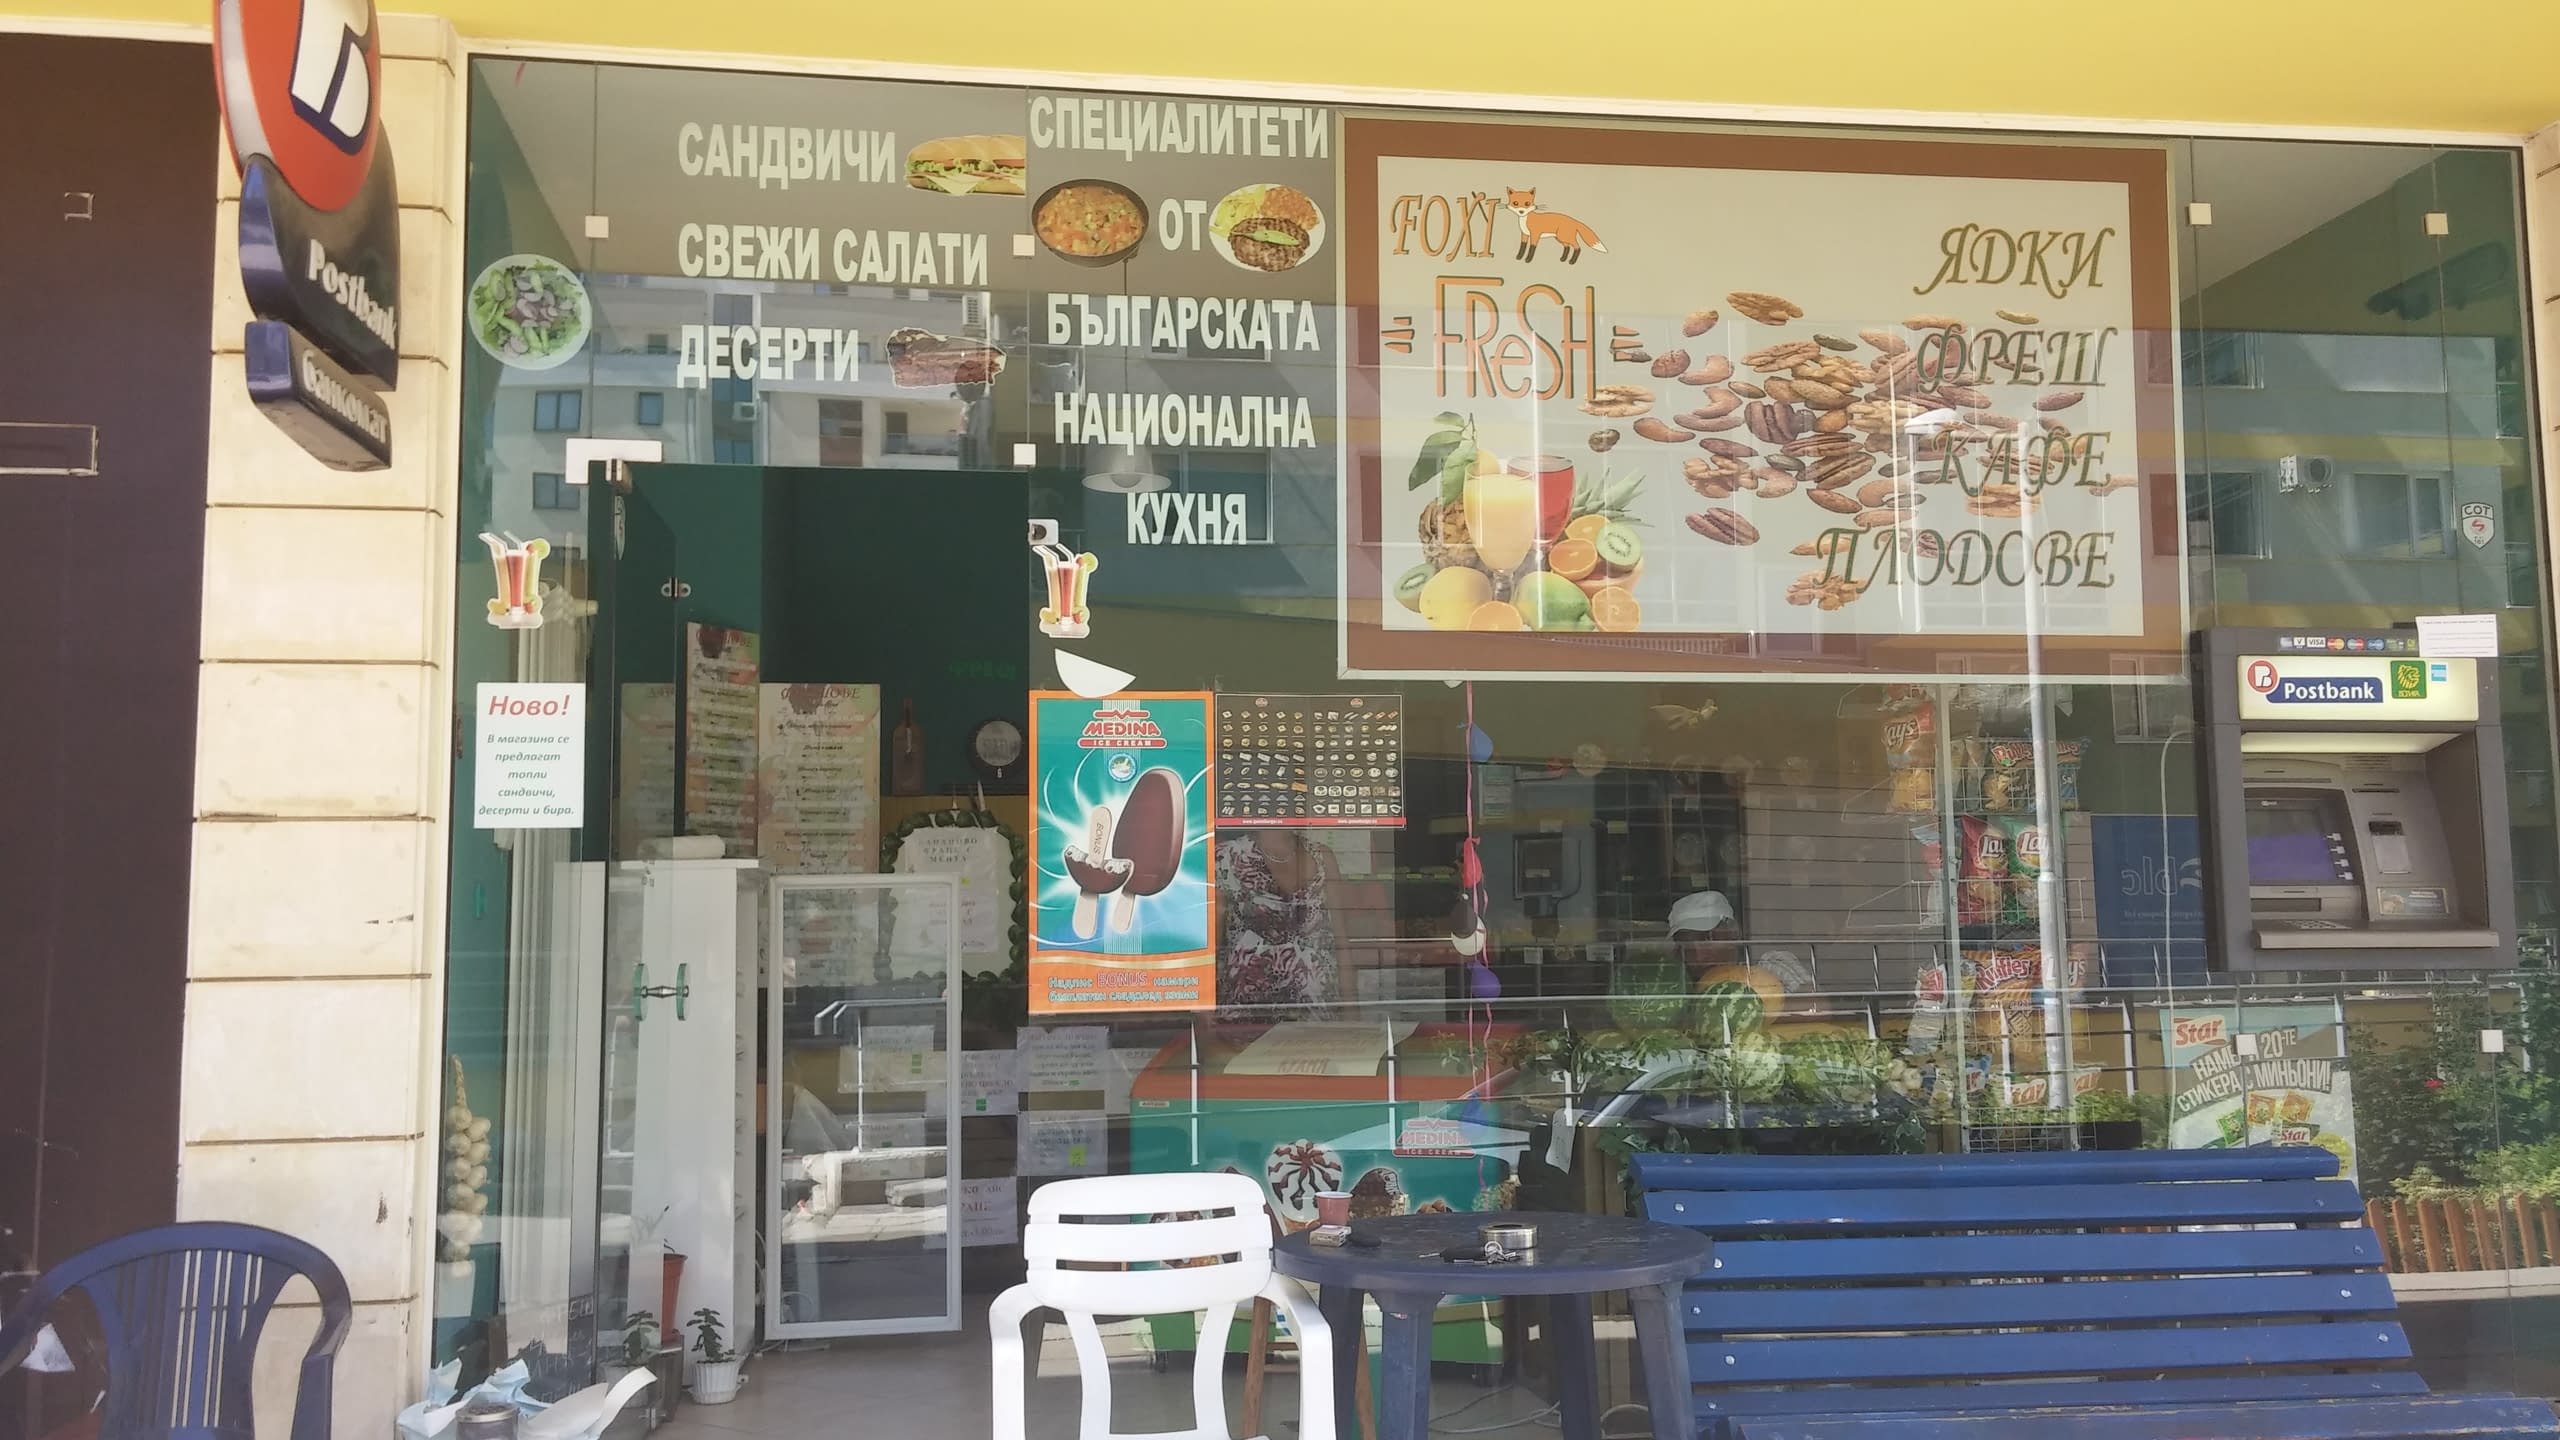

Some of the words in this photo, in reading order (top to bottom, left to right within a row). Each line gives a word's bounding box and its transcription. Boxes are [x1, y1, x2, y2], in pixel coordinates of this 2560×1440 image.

[1030, 96, 1328, 161] СПЕЦИАЛИТЕТИ
[678, 122, 896, 190] САНДВИЧИ
[1158, 198, 1207, 251] ОТ
[678, 223, 820, 280] СВЕЖИ
[833, 228, 988, 286] САЛАТИ
[1913, 223, 2115, 299] ЯДКИ
[308, 239, 397, 351] Postbank
[1047, 293, 1320, 351] БЪЛГАРСКАТА
[677, 324, 859, 389] ДЕСЕРТИ
[1917, 323, 2118, 394] ФРЕШ
[1055, 392, 1316, 456] НАЦИОНАЛНА
[1932, 425, 2111, 497] КАФЕ
[1127, 492, 1247, 545] КУХНЯ
[1813, 522, 2115, 594] ПЛОДОВЕ
[488, 694, 570, 716] Ново!
[2284, 682, 2375, 699] Postbank
[487, 734, 495, 743] В
[497, 735, 554, 744] магазина
[557, 736, 570, 744] се
[1083, 721, 1161, 736] MEDINA
[1093, 739, 1112, 747] ICE
[1116, 739, 1152, 747] CREAM
[494, 752, 561, 763] предлагат
[508, 771, 547, 779] топли
[479, 805, 530, 816] десерти
[533, 807, 540, 815] и
[543, 804, 574, 816] бира.
[498, 788, 556, 798] сандвичи,
[1097, 971, 1149, 987] BONUS
[1976, 956, 2032, 992] Ruffles
[2175, 1018, 2222, 1046] Star
[2260, 1028, 2298, 1059] 20-ТЕ
[2177, 1070, 2244, 1113] СТИКЕРА
[2253, 1060, 2332, 1093] МИНЬОНИ!
[2281, 1127, 2308, 1141] Star
